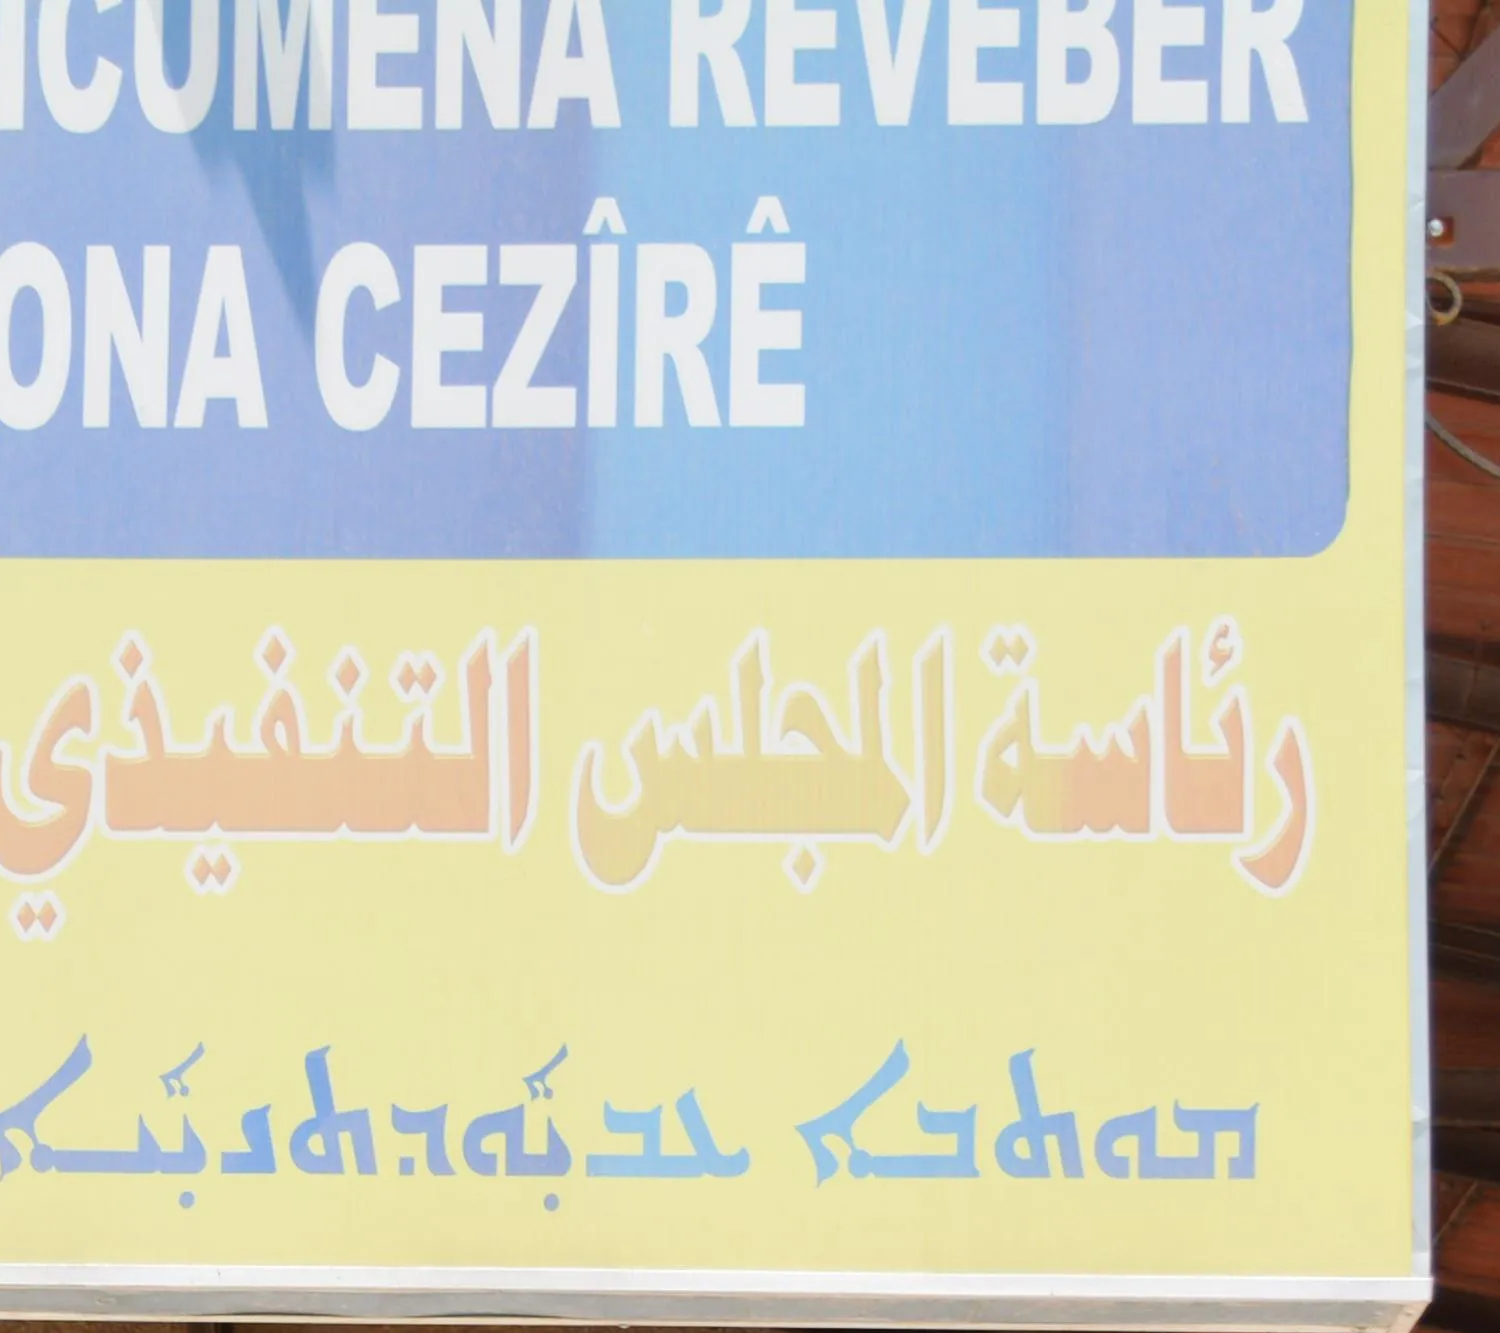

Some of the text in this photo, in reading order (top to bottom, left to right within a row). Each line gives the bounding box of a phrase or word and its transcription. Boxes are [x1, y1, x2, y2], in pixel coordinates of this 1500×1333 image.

[315, 196, 806, 431] CEZÎRÊ
[574, 626, 951, 890] المجلس
[980, 618, 1312, 893] رئاسة
